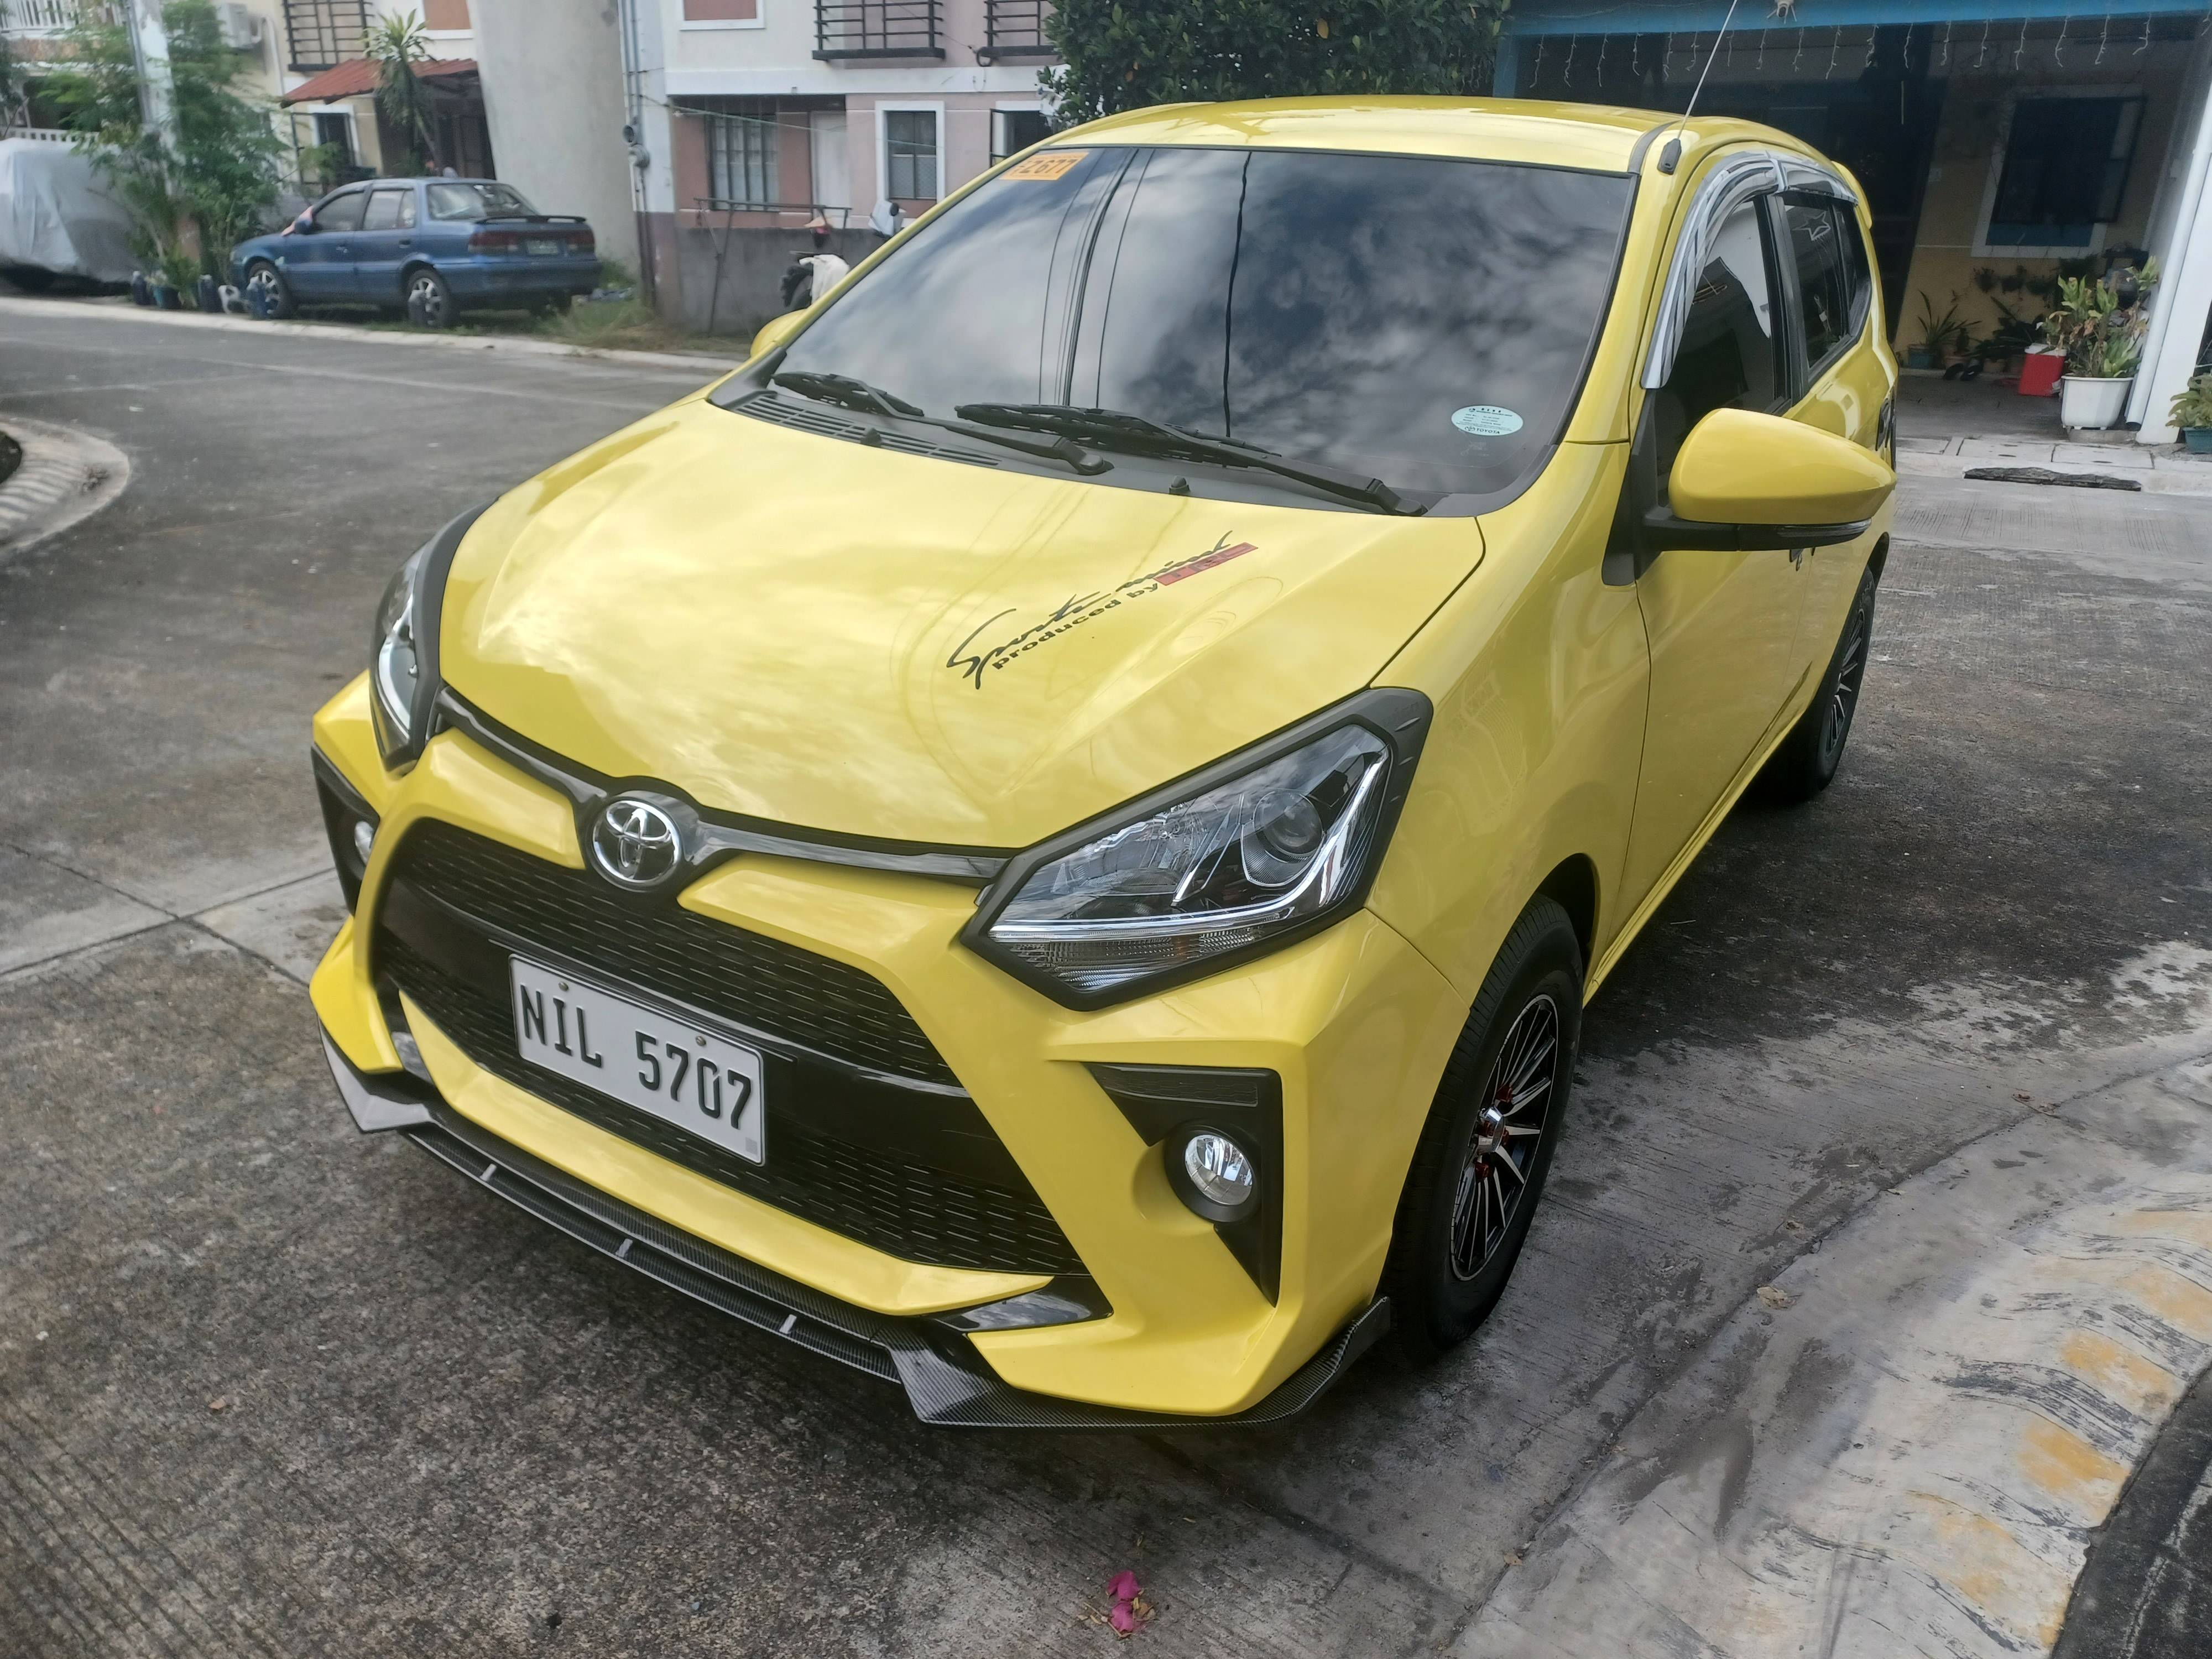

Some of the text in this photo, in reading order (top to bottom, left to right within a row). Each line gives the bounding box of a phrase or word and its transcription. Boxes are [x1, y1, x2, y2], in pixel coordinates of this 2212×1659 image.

[992, 599, 1121, 670] produced
[1126, 582, 1158, 598] by
[520, 984, 752, 1130] NIL 5707
